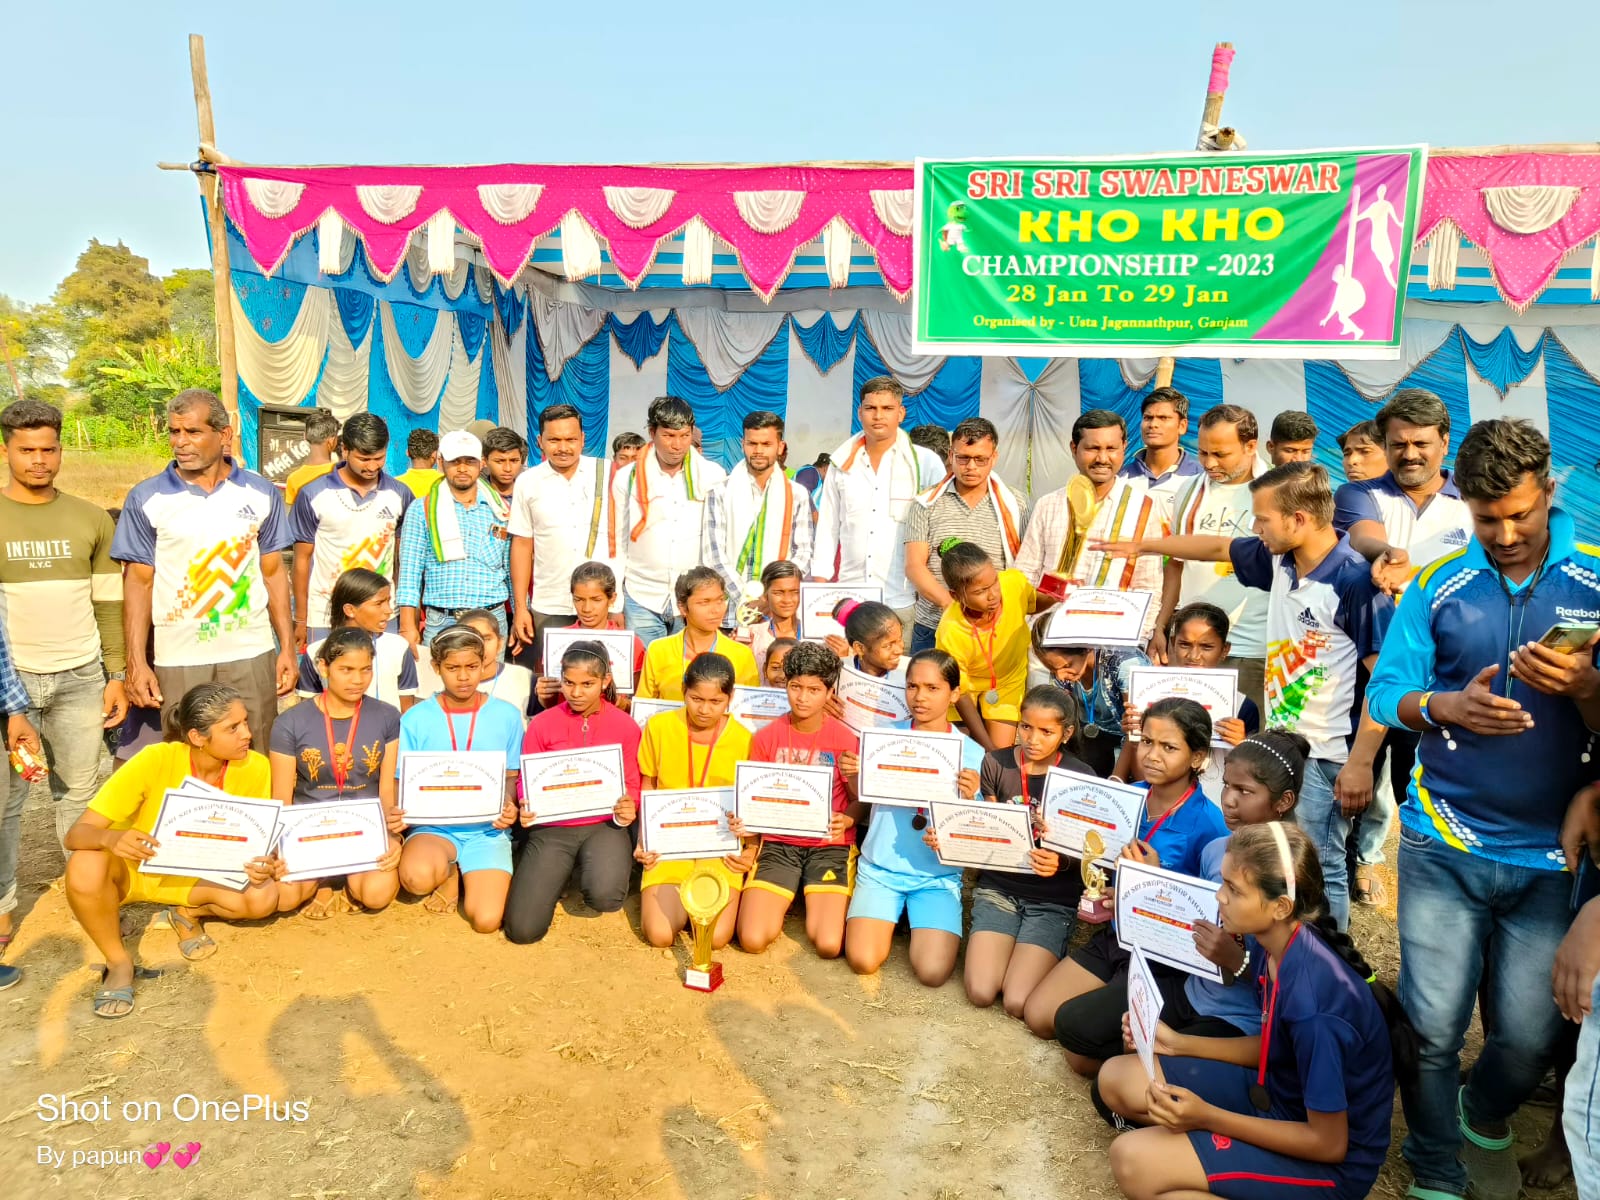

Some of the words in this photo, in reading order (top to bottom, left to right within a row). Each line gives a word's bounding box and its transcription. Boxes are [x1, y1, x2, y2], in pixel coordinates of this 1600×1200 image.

[968, 170, 1023, 199] SRI
[1033, 168, 1090, 198] SRI
[1100, 162, 1341, 199] SWAPNESWAR
[1018, 209, 1140, 243] KHO
[1161, 206, 1285, 242] KHO
[962, 254, 1198, 277] CHAMPIONSHIP
[1006, 284, 1037, 303] 28
[1044, 284, 1088, 307] Jan
[1097, 284, 1135, 303] To
[1144, 284, 1176, 303] 29
[1182, 284, 1229, 307] Jan
[973, 314, 1036, 330] Organised
[1040, 315, 1056, 331] by
[1069, 315, 1098, 328] Usta
[1101, 315, 1194, 331] Jagannathpur,
[1198, 316, 1249, 331] Ganjam
[6, 539, 72, 558] INFINITE
[1297, 614, 1320, 629] adidas
